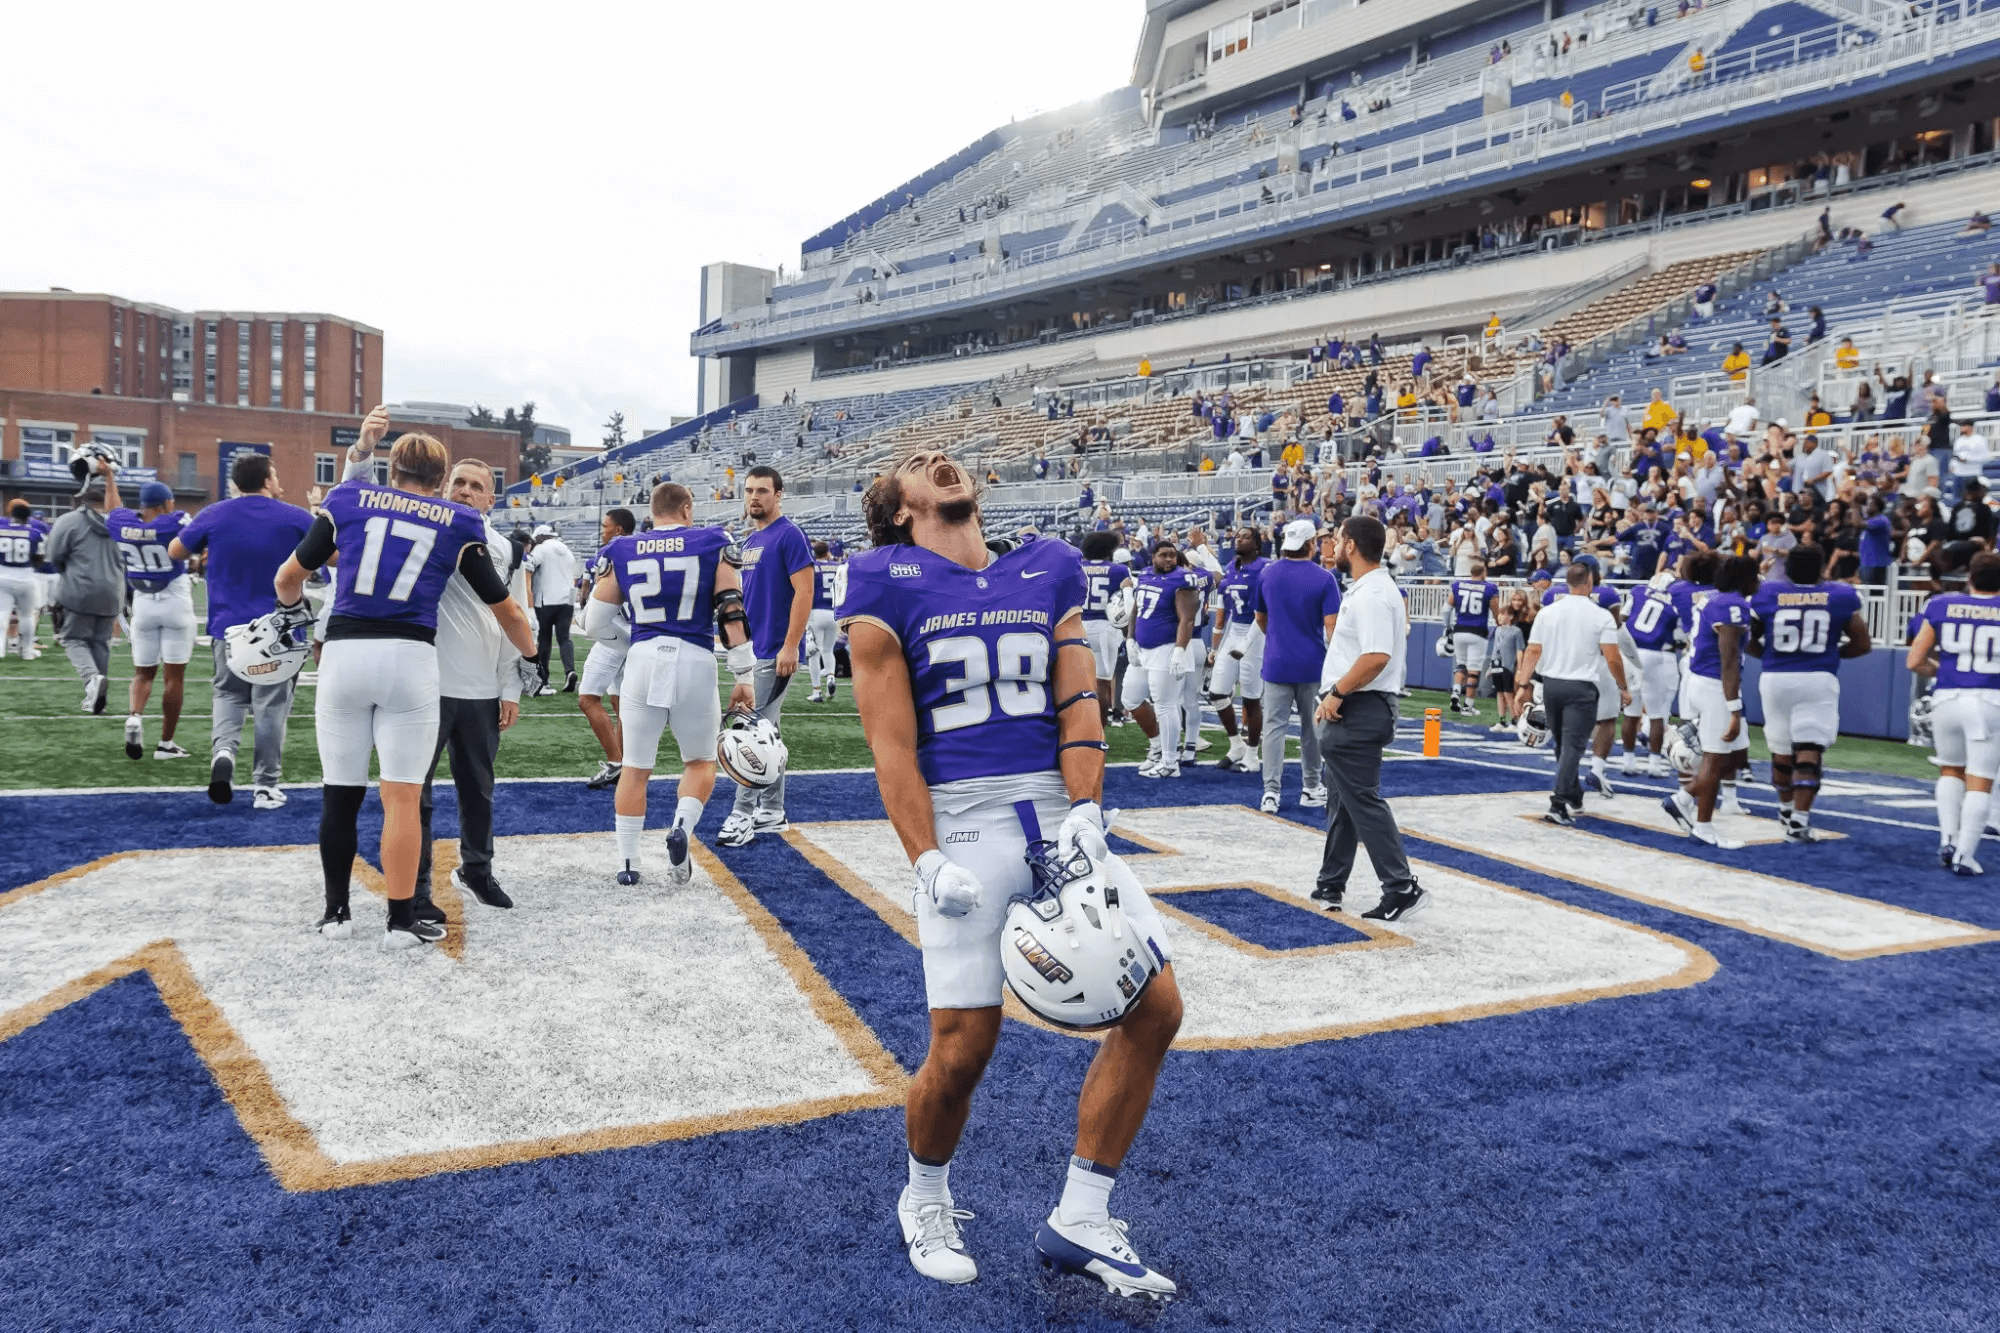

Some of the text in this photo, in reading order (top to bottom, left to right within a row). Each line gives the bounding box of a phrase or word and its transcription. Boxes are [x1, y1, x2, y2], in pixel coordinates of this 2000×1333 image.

[358, 489, 456, 527] THOMPSON
[354, 516, 438, 602] 17
[637, 537, 685, 555] DOBBS
[889, 563, 922, 578] SBC
[627, 555, 700, 625] 27
[1458, 589, 1484, 615] 76
[919, 609, 1049, 635] JAMES MADISON
[1634, 598, 1665, 634] 0
[1729, 606, 1742, 623] 2
[1773, 608, 1831, 653] 60
[1941, 622, 2000, 674] 40
[926, 632, 1050, 733] 38
[945, 830, 980, 845] JMU
[1014, 930, 1074, 985] JMU
